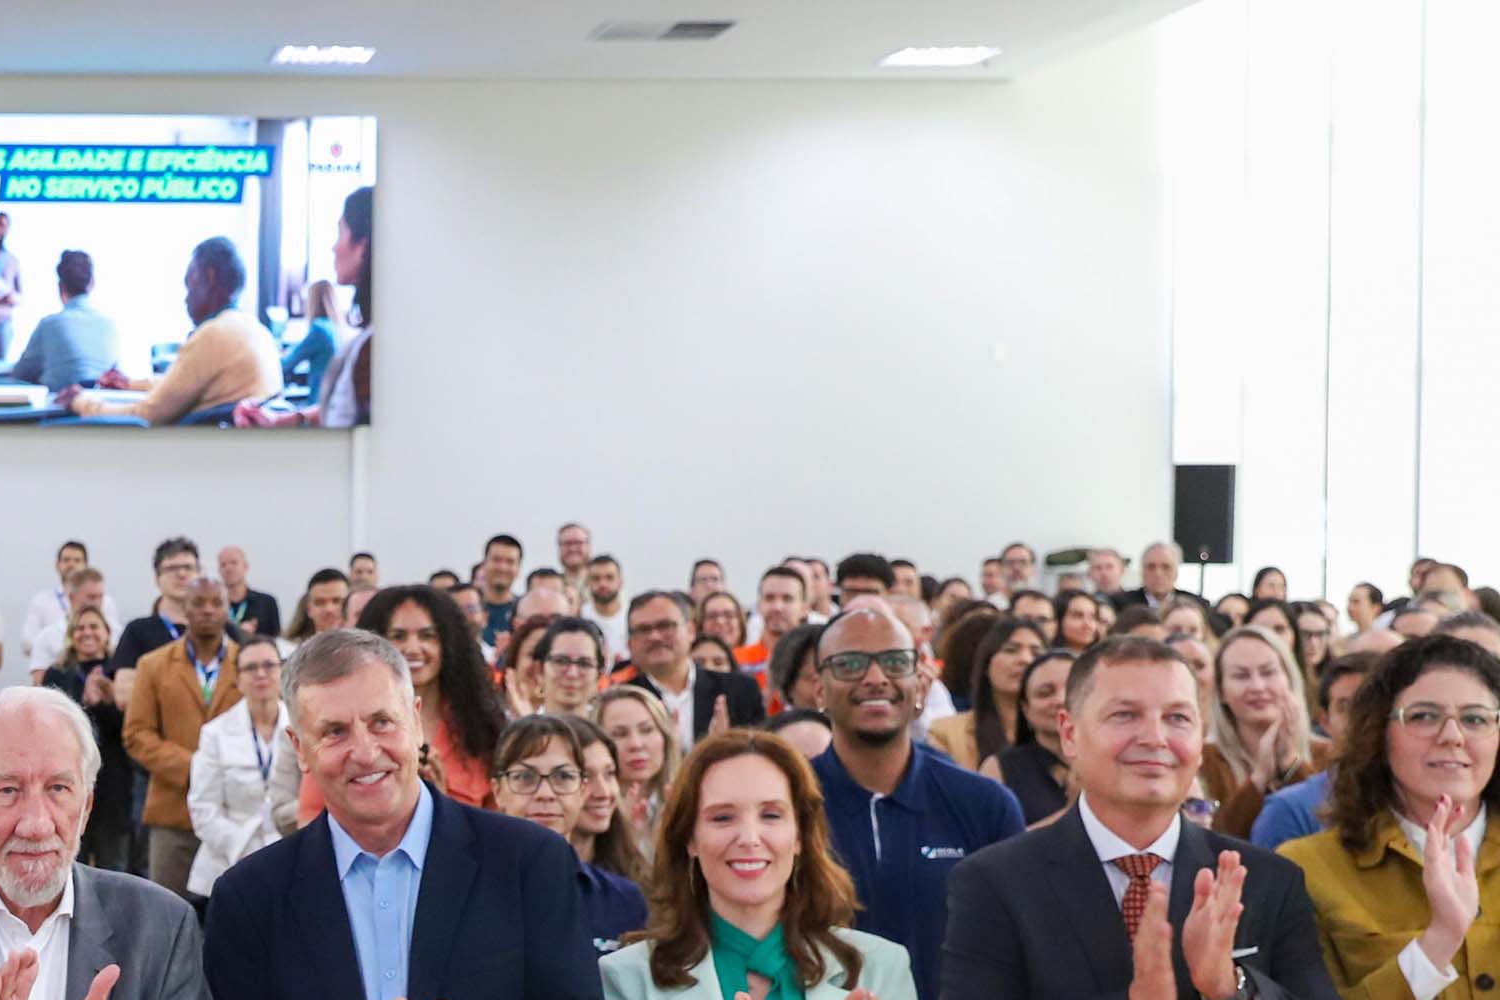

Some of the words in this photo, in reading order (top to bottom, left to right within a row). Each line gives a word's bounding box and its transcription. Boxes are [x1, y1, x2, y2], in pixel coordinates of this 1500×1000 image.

[8, 148, 125, 171] AGILIDADE
[127, 149, 146, 171] E
[147, 145, 268, 172] EFICIÊNCIA
[6, 175, 41, 198] NO
[43, 175, 140, 201] SERVIÇO
[141, 172, 238, 199] PÚBLICO
